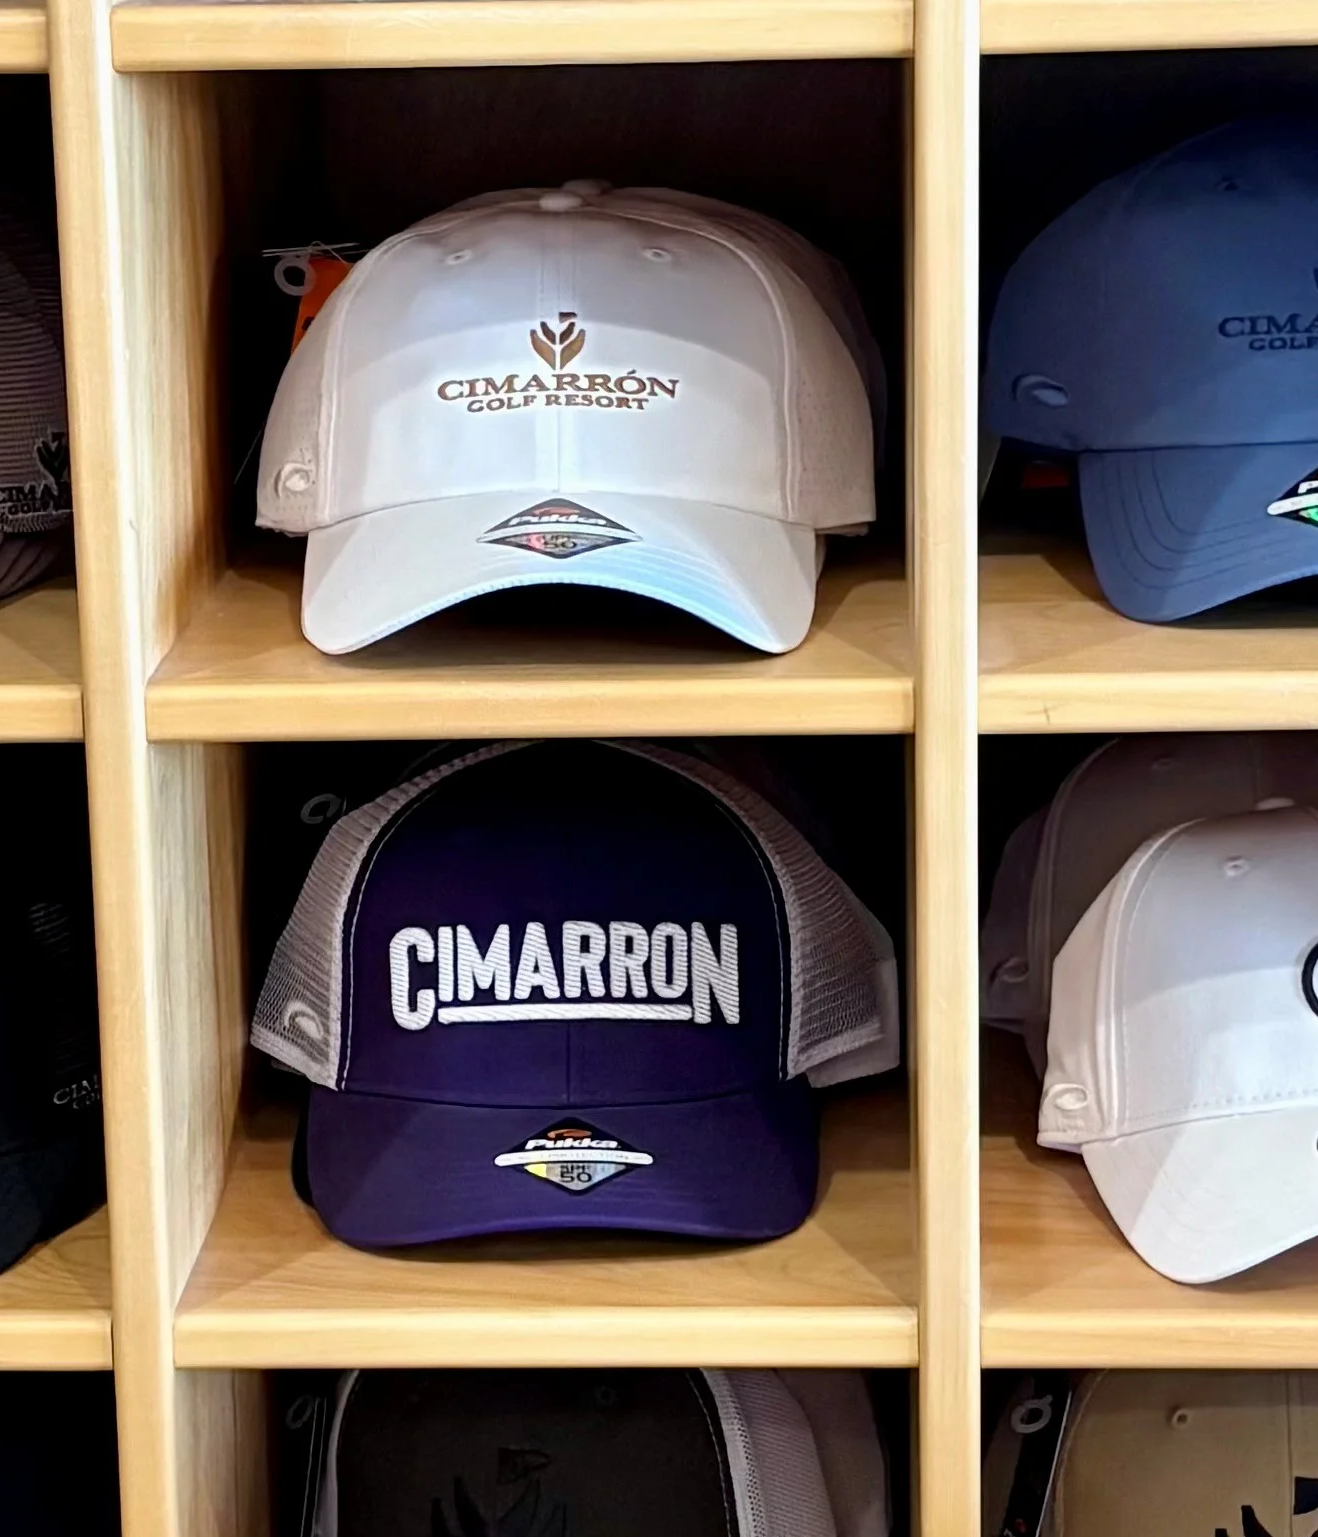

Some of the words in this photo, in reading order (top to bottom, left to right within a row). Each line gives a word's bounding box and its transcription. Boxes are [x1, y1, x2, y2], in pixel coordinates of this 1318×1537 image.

[1249, 334, 1318, 351] GOLF
[436, 369, 680, 402] CIMARRÓN
[466, 393, 537, 414] GOLF
[543, 391, 651, 411] RESORT
[387, 920, 741, 1031] CIMARRON
[525, 1139, 621, 1150] Pukka
[559, 1172, 592, 1184] 50
